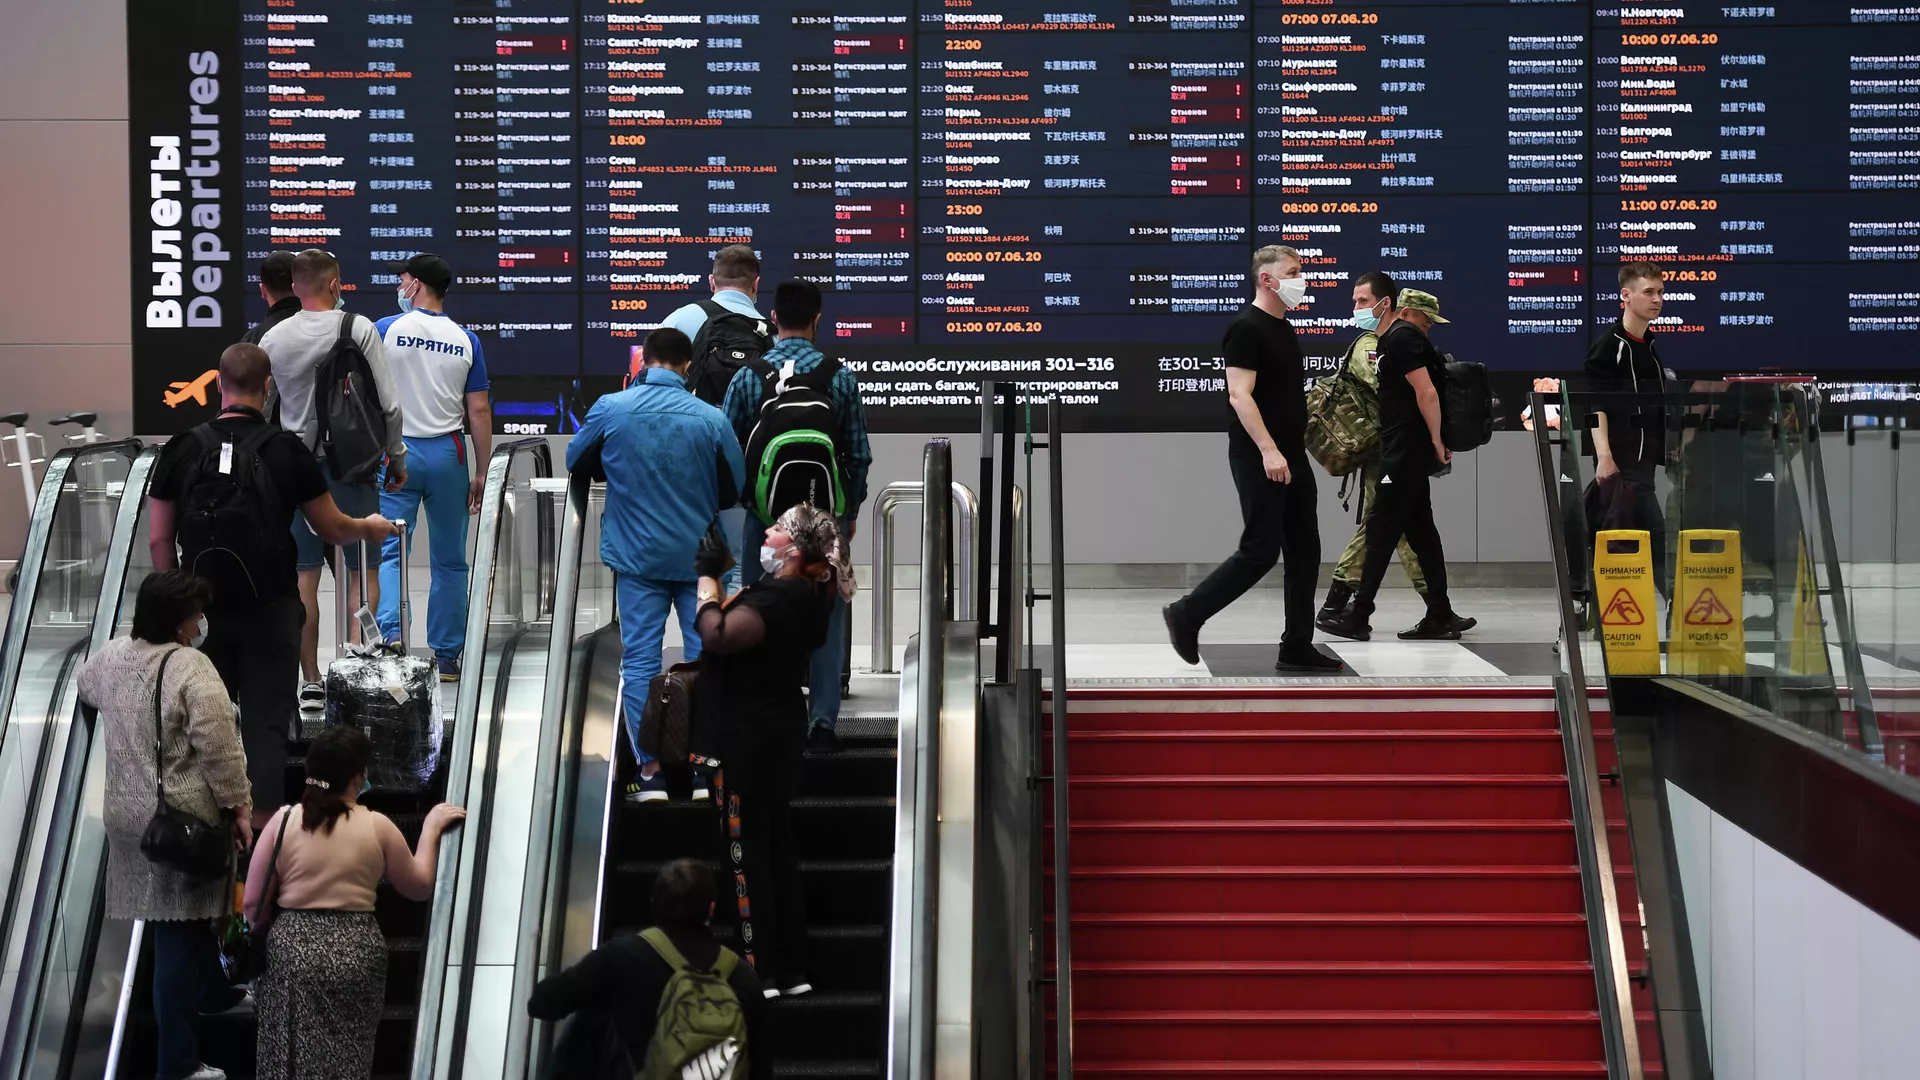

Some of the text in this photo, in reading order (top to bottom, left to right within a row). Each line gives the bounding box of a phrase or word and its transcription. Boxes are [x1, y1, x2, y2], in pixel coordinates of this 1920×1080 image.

[268, 14, 328, 22] Махачкала
[608, 14, 701, 23] Южно-Сахалинск
[1621, 8, 1684, 19] Н.Новгород
[945, 14, 1003, 24] Краснодар
[1282, 14, 1378, 24] 07:00 07.06.20
[268, 37, 315, 46] Нальчик
[607, 38, 699, 49] Санкт-Петербург
[1282, 35, 1351, 44] Нижнекамск
[1622, 34, 1717, 45] 10:00 07.06.20
[946, 40, 981, 50] 22:00
[268, 61, 310, 71] Самара
[608, 61, 666, 72] Хабаровск
[945, 61, 1002, 69] Челябинск
[1282, 59, 1337, 70] Мурманск
[1621, 56, 1677, 67] Волгоград
[945, 85, 974, 93] Омск
[1282, 82, 1357, 93] Симферополь
[1621, 79, 1675, 89] Мин.Воды
[269, 85, 305, 95] Пермь
[608, 85, 684, 96] Симферополь
[945, 108, 981, 118] Пермь
[1282, 106, 1317, 116] Пермь
[1621, 103, 1692, 113] Калининград
[269, 109, 361, 119] Санкт-Петербург
[609, 109, 665, 119] Волгоград
[946, 132, 1030, 142] Нижневартовск
[1282, 129, 1367, 141] Ростов-на-Дону
[1621, 127, 1672, 138] Белгород
[269, 133, 326, 143] Мурманск
[610, 135, 645, 145] 18:00
[946, 155, 1000, 165] Кемерово
[1282, 153, 1324, 162] Бишкек
[1620, 150, 1712, 160] Санкт-Петербург
[270, 156, 344, 166] Екатеринбург
[609, 156, 636, 165] Сочи
[946, 179, 1030, 188] Ростов-на-Дону
[1282, 177, 1351, 188] Владикавказ
[1620, 174, 1677, 183] Ульяновск
[184, 50, 230, 328] Departures
[270, 180, 356, 191] Ростов-на-Дону
[609, 180, 642, 188] Анапа
[270, 203, 323, 213] Оренбург
[609, 203, 678, 213] Владивосток
[947, 205, 982, 214] 23:00
[1282, 203, 1377, 213] 08:00 07.06.20
[1622, 200, 1717, 210] 11:00 07.06.20
[146, 135, 182, 327] Вылеты
[271, 227, 341, 236] Владивосток
[607, 227, 681, 237] Калининград
[945, 226, 988, 234] Тюмень
[1282, 224, 1341, 232] Махачкала
[1620, 221, 1696, 233] Симферополь
[1620, 245, 1678, 254] Челябинск
[609, 250, 668, 260] Хабаровск
[946, 252, 1041, 261] 00:00 07.06.20
[610, 273, 701, 285] Санкт-Петербург
[946, 272, 984, 281] Абакан
[612, 300, 647, 310] 19:00
[946, 296, 975, 305] Омск
[947, 322, 1042, 332] 01:00 07.06.20
[396, 335, 464, 357] БУРЯТИЯ
[872, 358, 1041, 374] самообслуживания
[894, 382, 932, 392] сдать
[935, 380, 980, 392] багаж,
[1158, 378, 1226, 392] 打印登机牌
[862, 396, 887, 405] или
[890, 395, 971, 407] распечатать
[1060, 395, 1099, 404] талон
[503, 423, 548, 435] SPORT
[1604, 633, 1641, 641] CAUTION
